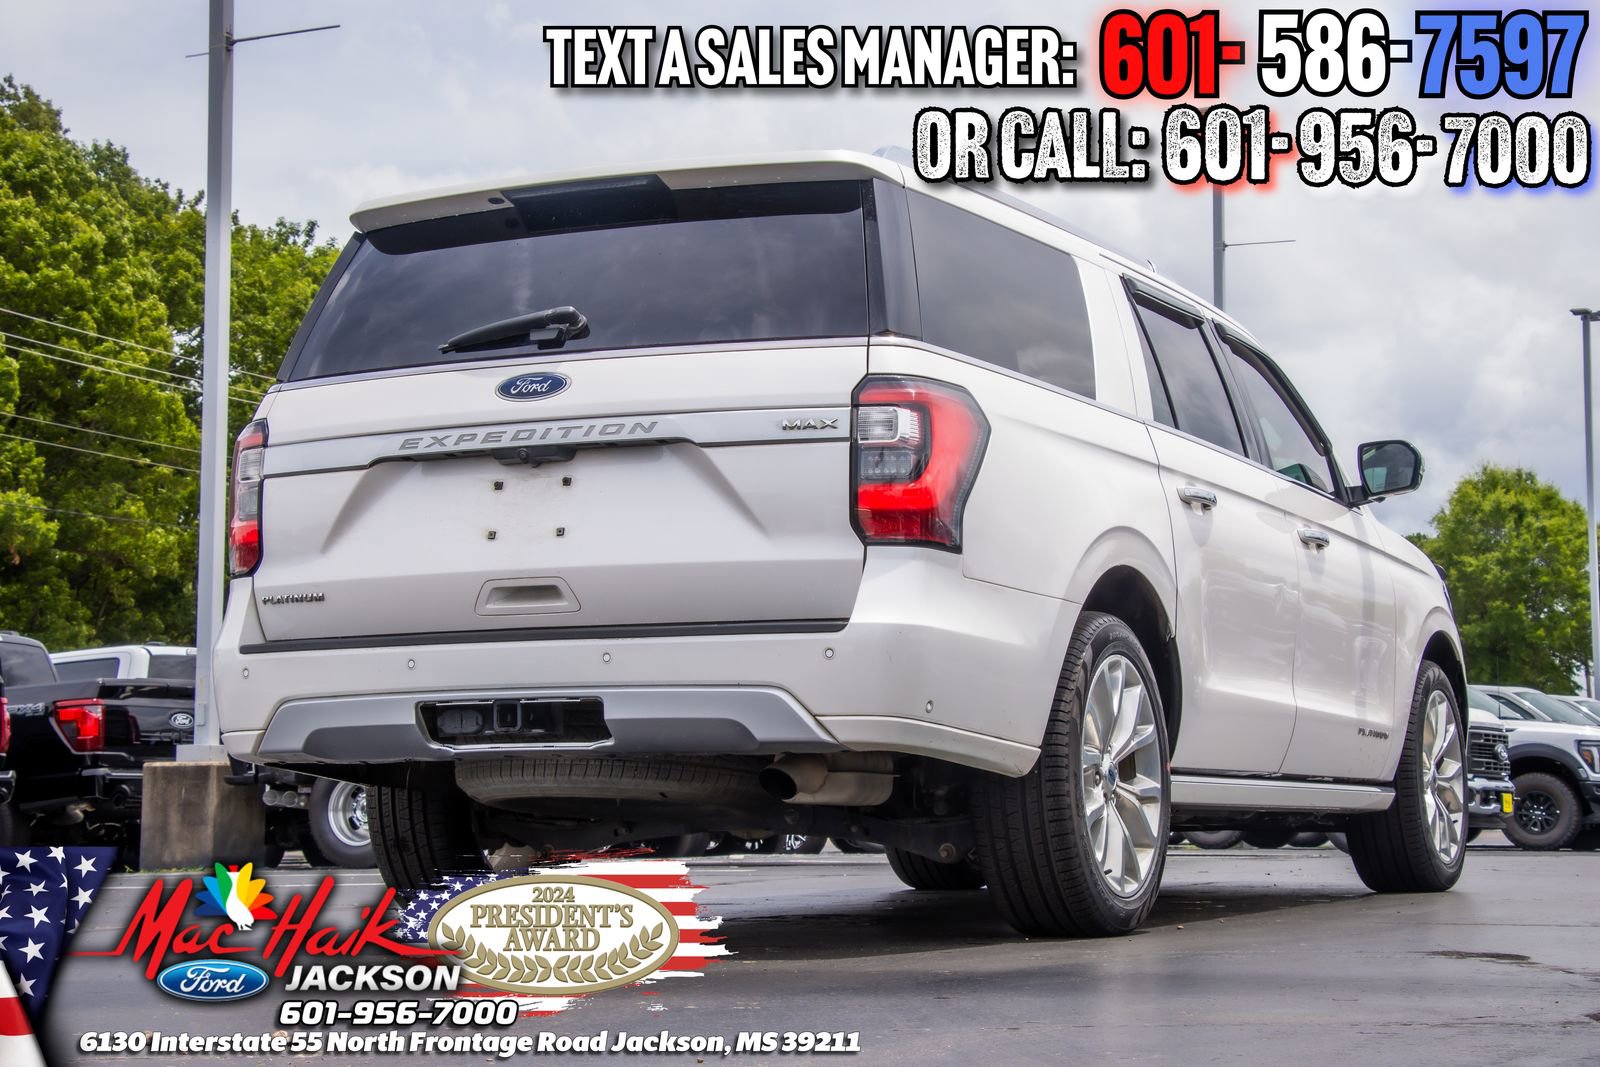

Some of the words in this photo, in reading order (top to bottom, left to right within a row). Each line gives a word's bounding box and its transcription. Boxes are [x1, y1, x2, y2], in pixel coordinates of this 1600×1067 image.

[510, 376, 553, 395] Ford
[781, 417, 840, 432] MAX
[398, 420, 659, 452] EXPEDITION
[262, 592, 325, 606] PLATINUM
